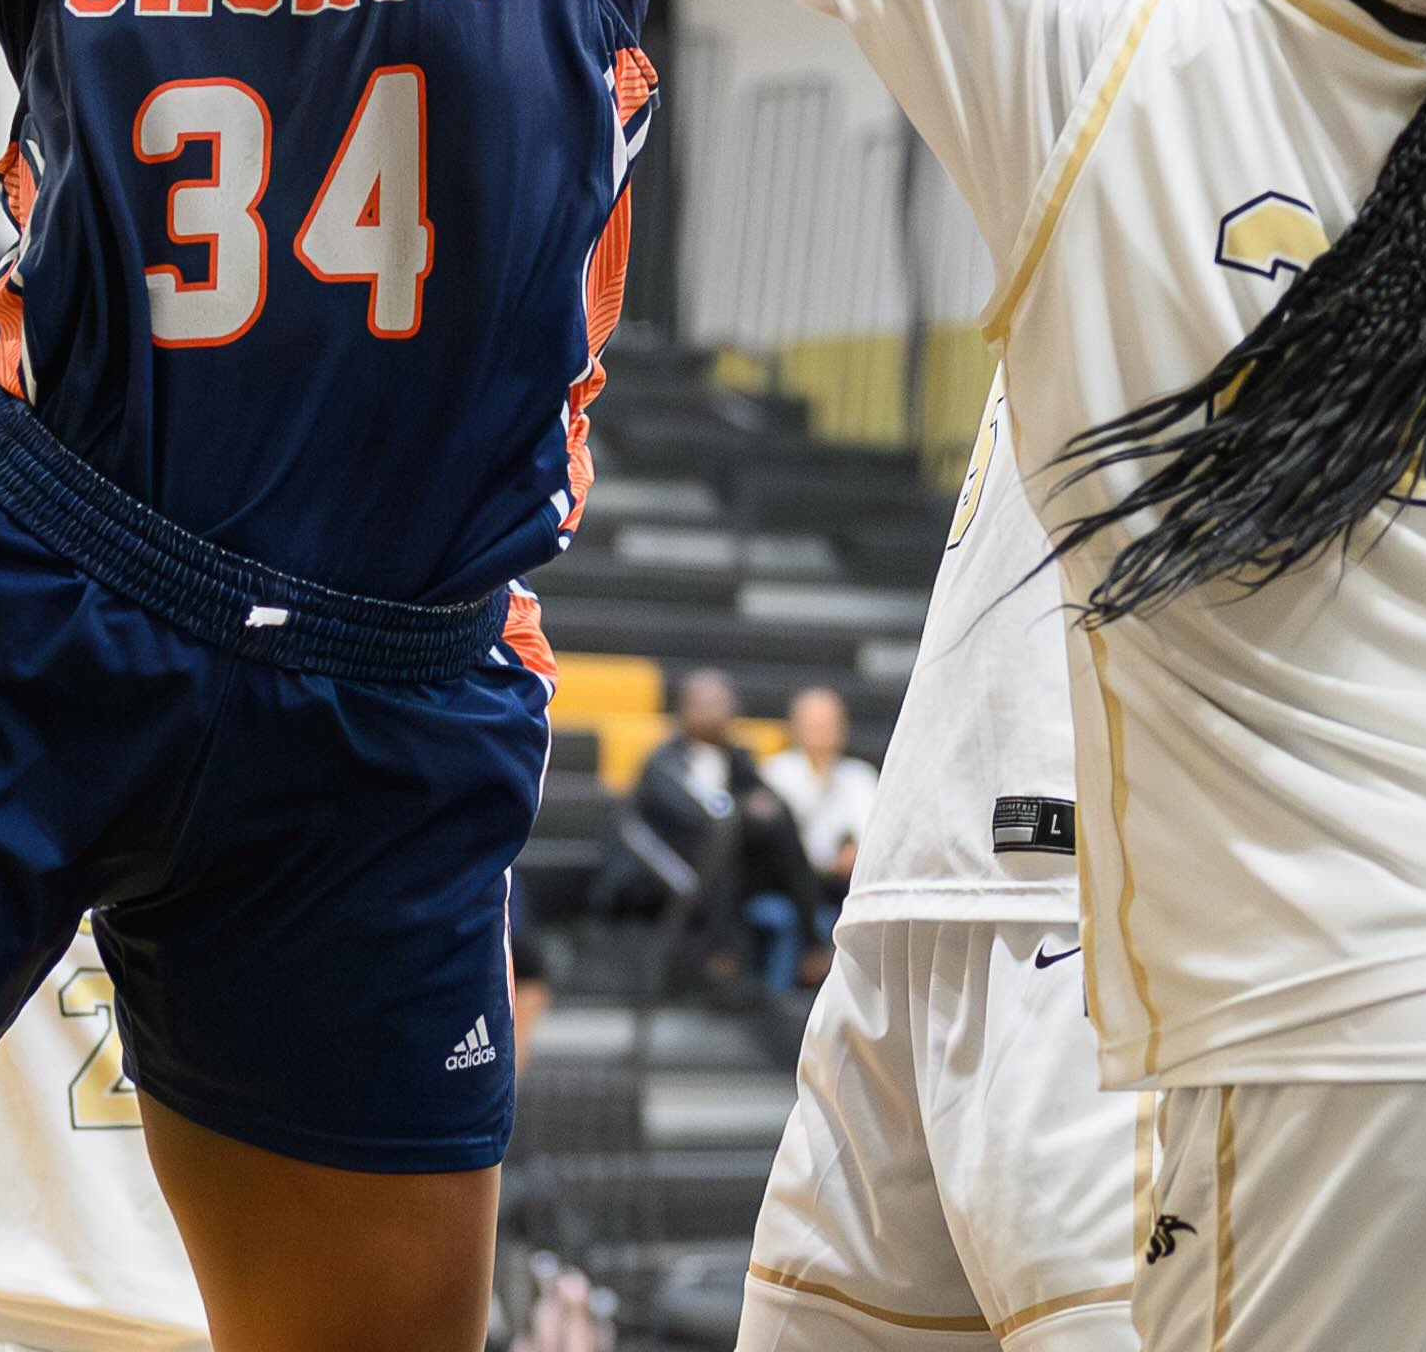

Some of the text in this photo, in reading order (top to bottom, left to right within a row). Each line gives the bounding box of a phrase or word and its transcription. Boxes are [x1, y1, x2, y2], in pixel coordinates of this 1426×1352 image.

[133, 64, 434, 347] 34
[1050, 813, 1062, 835] L
[445, 1045, 496, 1071] adidas
